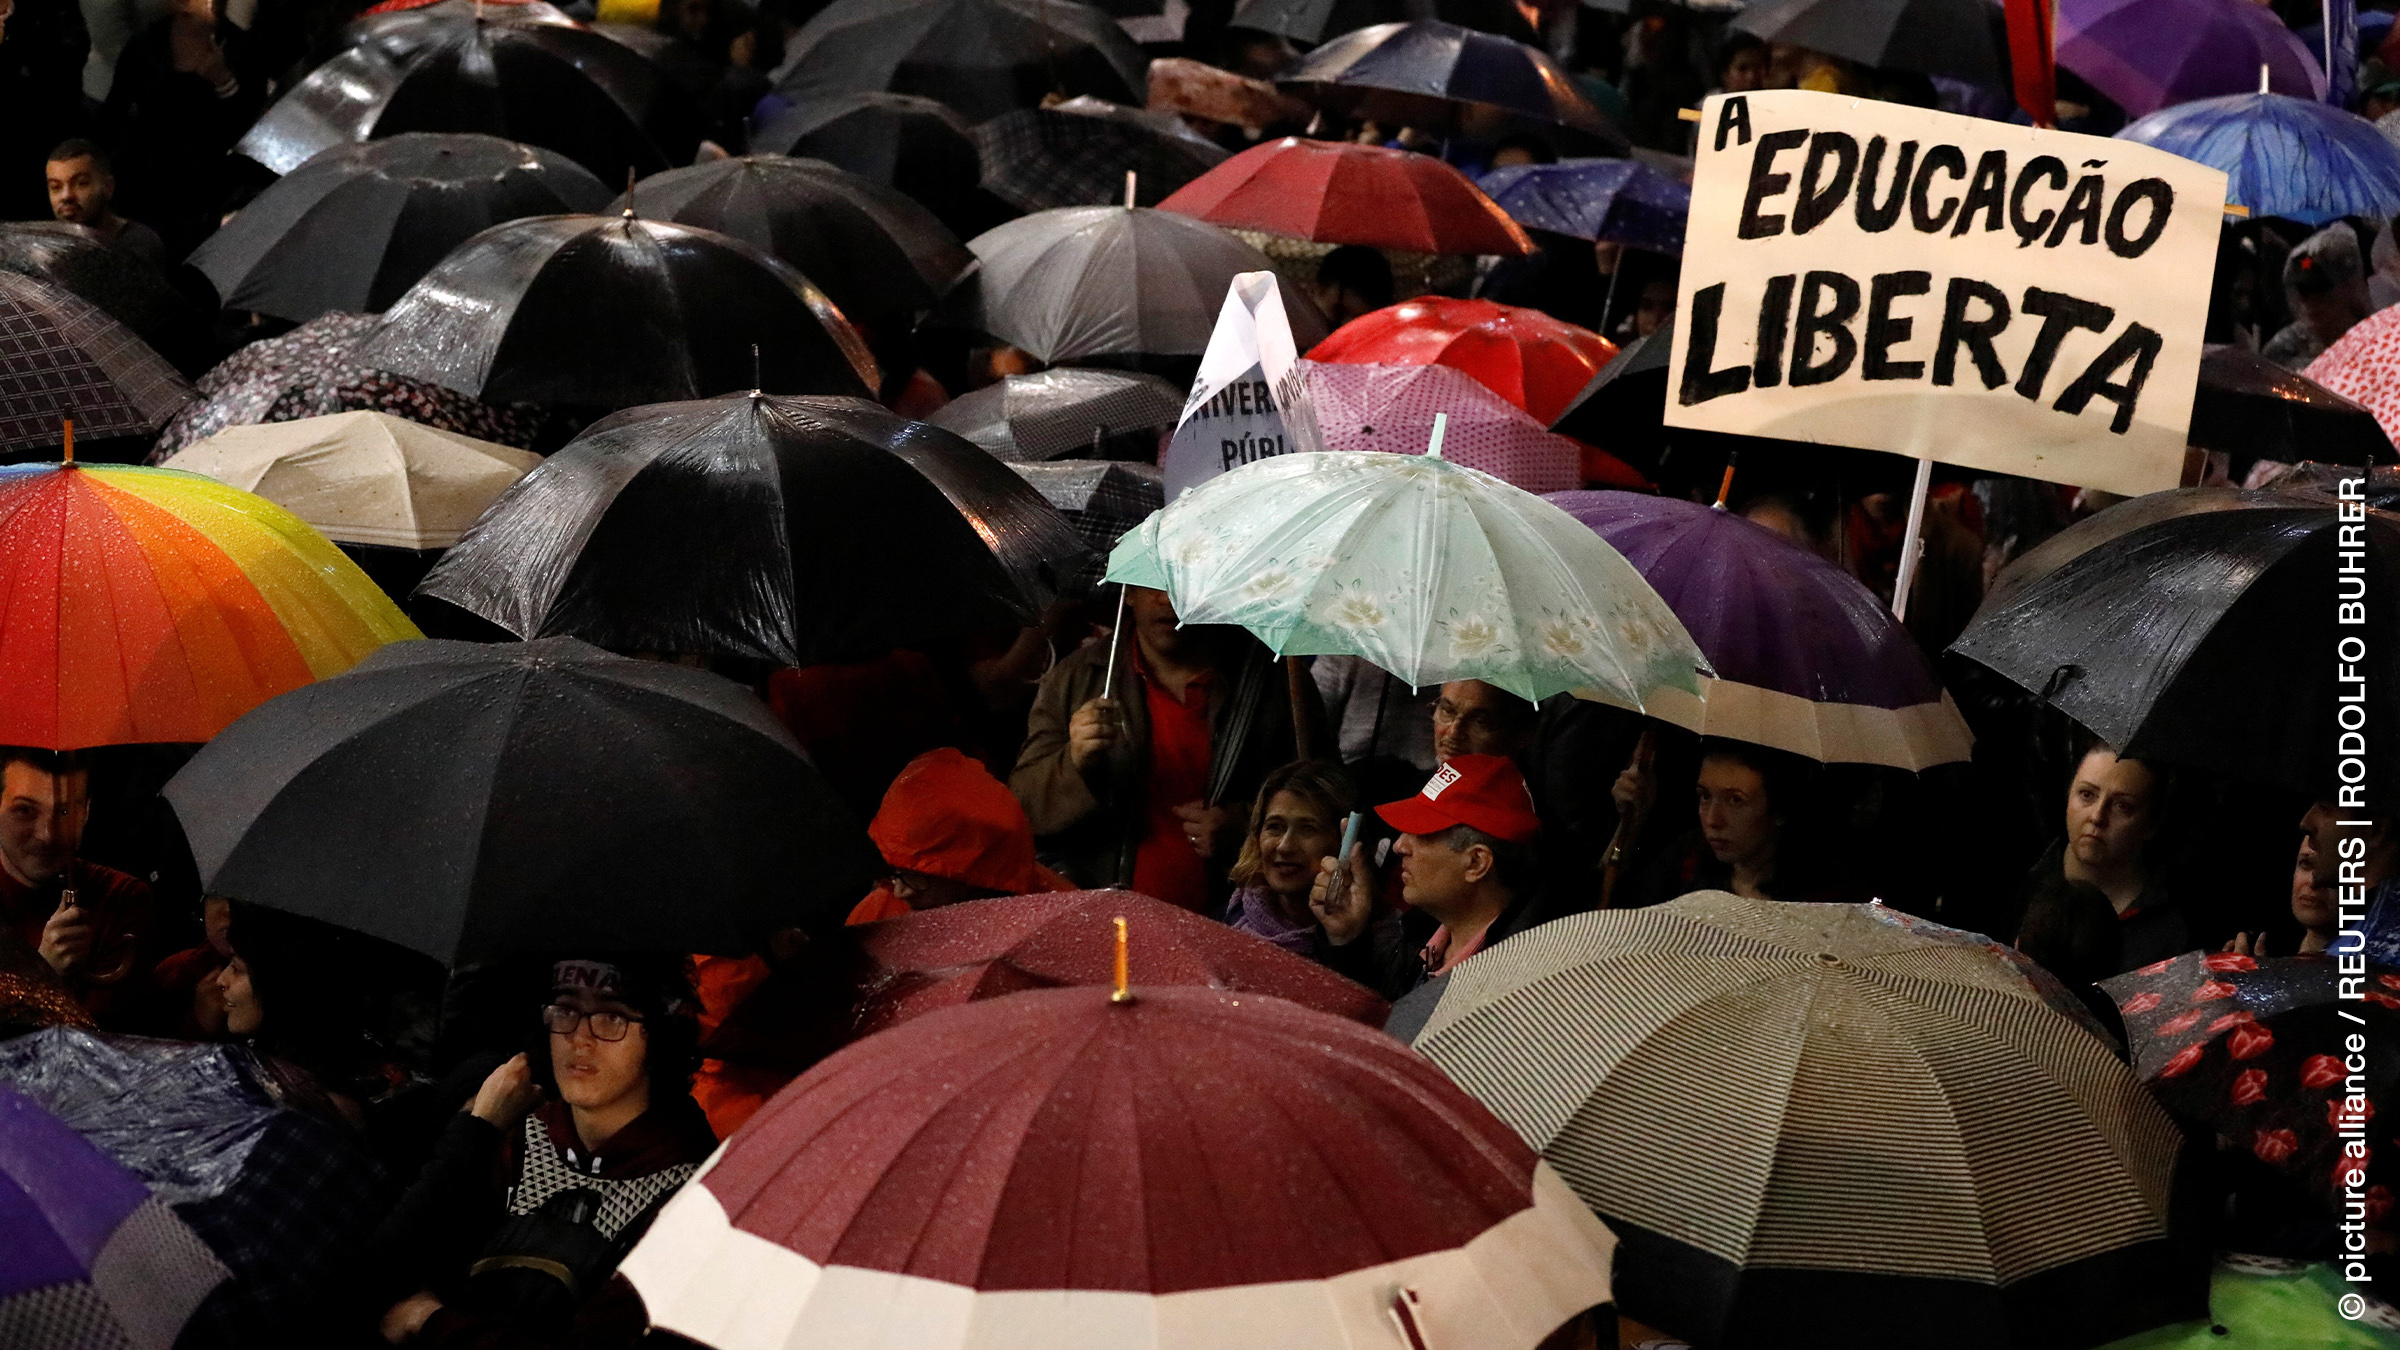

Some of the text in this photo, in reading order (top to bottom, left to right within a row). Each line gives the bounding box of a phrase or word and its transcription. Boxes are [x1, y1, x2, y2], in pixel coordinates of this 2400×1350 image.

[1714, 95, 1752, 152] A
[1737, 129, 2176, 260] EDUCAÇÃO
[1679, 270, 2163, 435] LIBERTA
